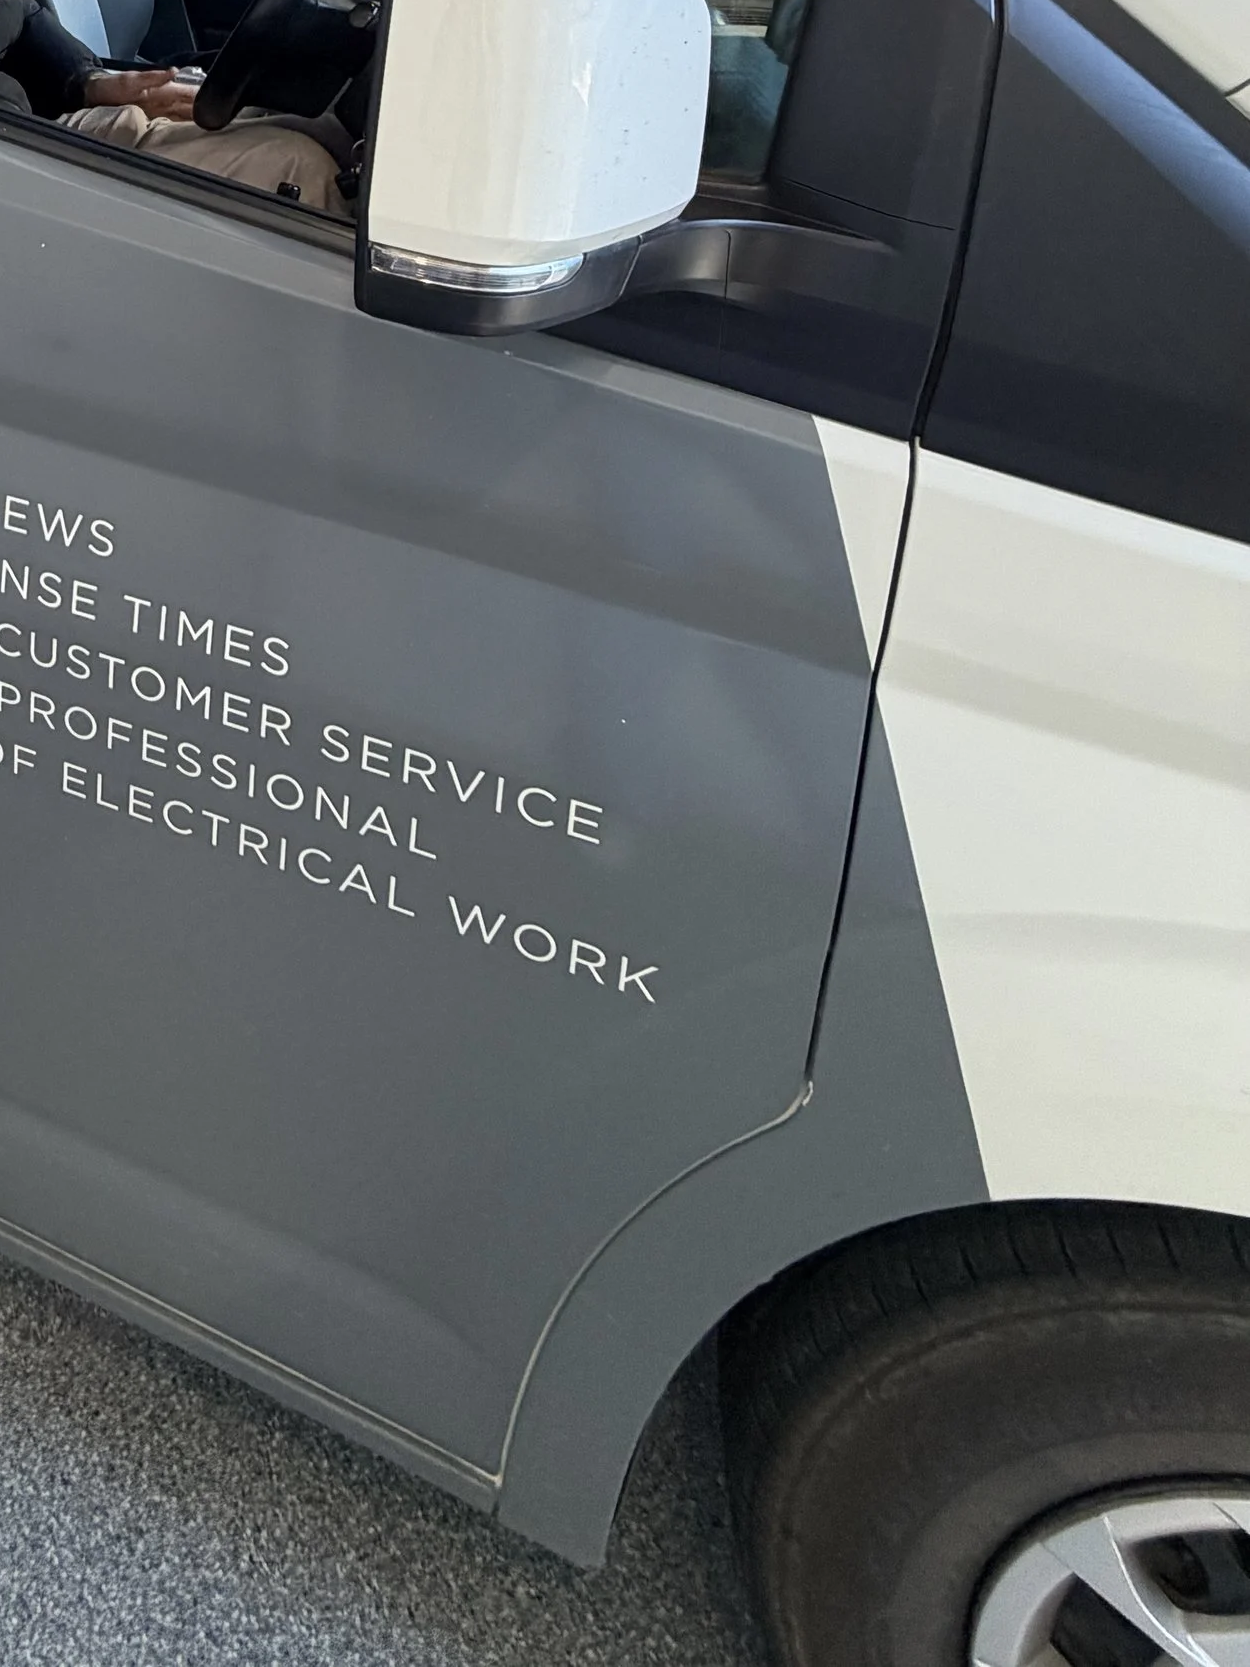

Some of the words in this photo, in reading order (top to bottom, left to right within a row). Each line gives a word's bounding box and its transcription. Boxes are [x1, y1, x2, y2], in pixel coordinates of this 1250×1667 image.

[123, 594, 290, 676] TIMES
[320, 724, 603, 845] SERVICE
[62, 761, 415, 918] ELECTRICAL
[448, 895, 659, 1004] WORK
